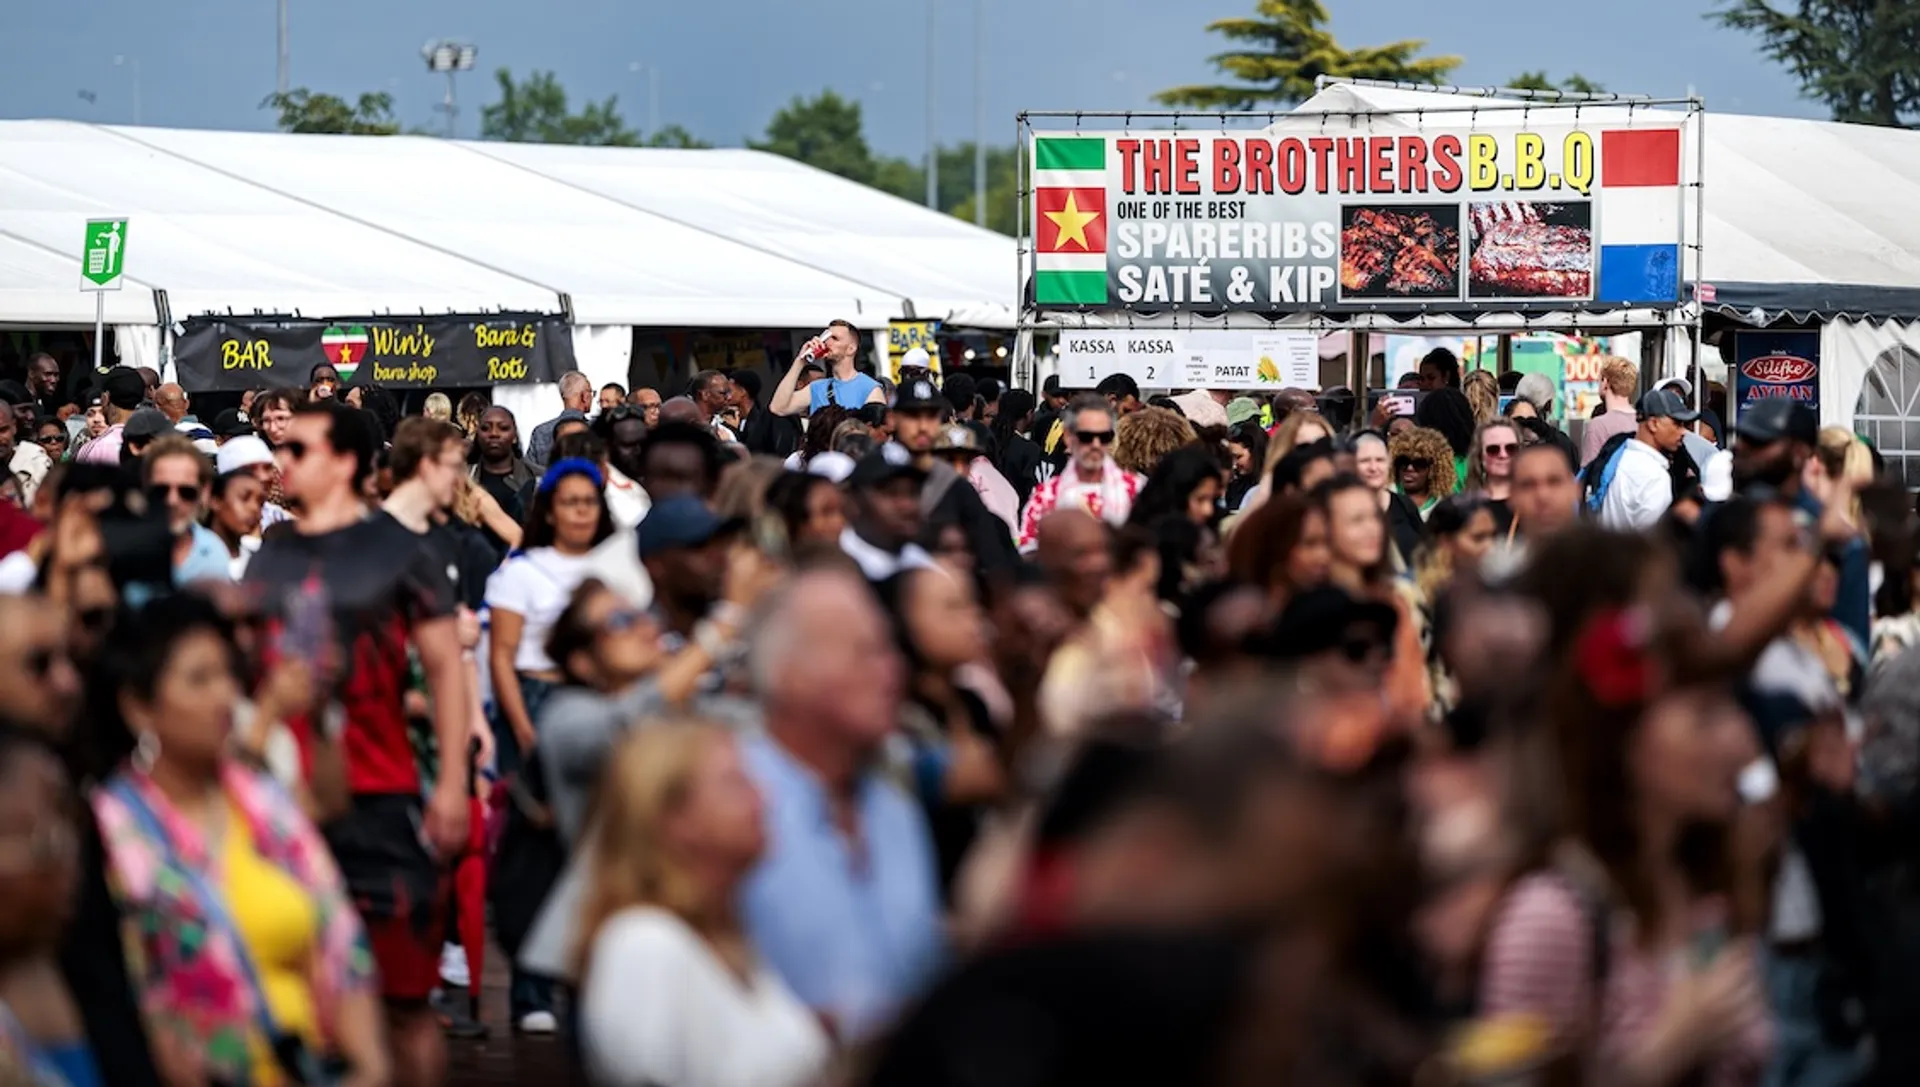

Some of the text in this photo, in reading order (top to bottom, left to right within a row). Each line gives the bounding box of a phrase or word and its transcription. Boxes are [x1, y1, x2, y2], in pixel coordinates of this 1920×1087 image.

[1116, 132, 1594, 196] THE BROTHERS B.B.Q
[1117, 201, 1246, 219] ONE OF THE BEST
[1117, 221, 1335, 259] SPARERIBS
[1118, 255, 1335, 303] SATÉ & KIP
[372, 324, 435, 357] Win's
[475, 324, 536, 348] Bara &
[1070, 340, 1115, 354] KASSA
[1128, 340, 1174, 354] KASSA
[222, 339, 273, 370] BAR
[374, 361, 437, 384] bara shop
[488, 357, 528, 380] Roti
[1088, 366, 1096, 379] 1
[1146, 366, 1155, 379] 2
[1215, 366, 1250, 376] PATAT
[1754, 360, 1806, 379] Silifke
